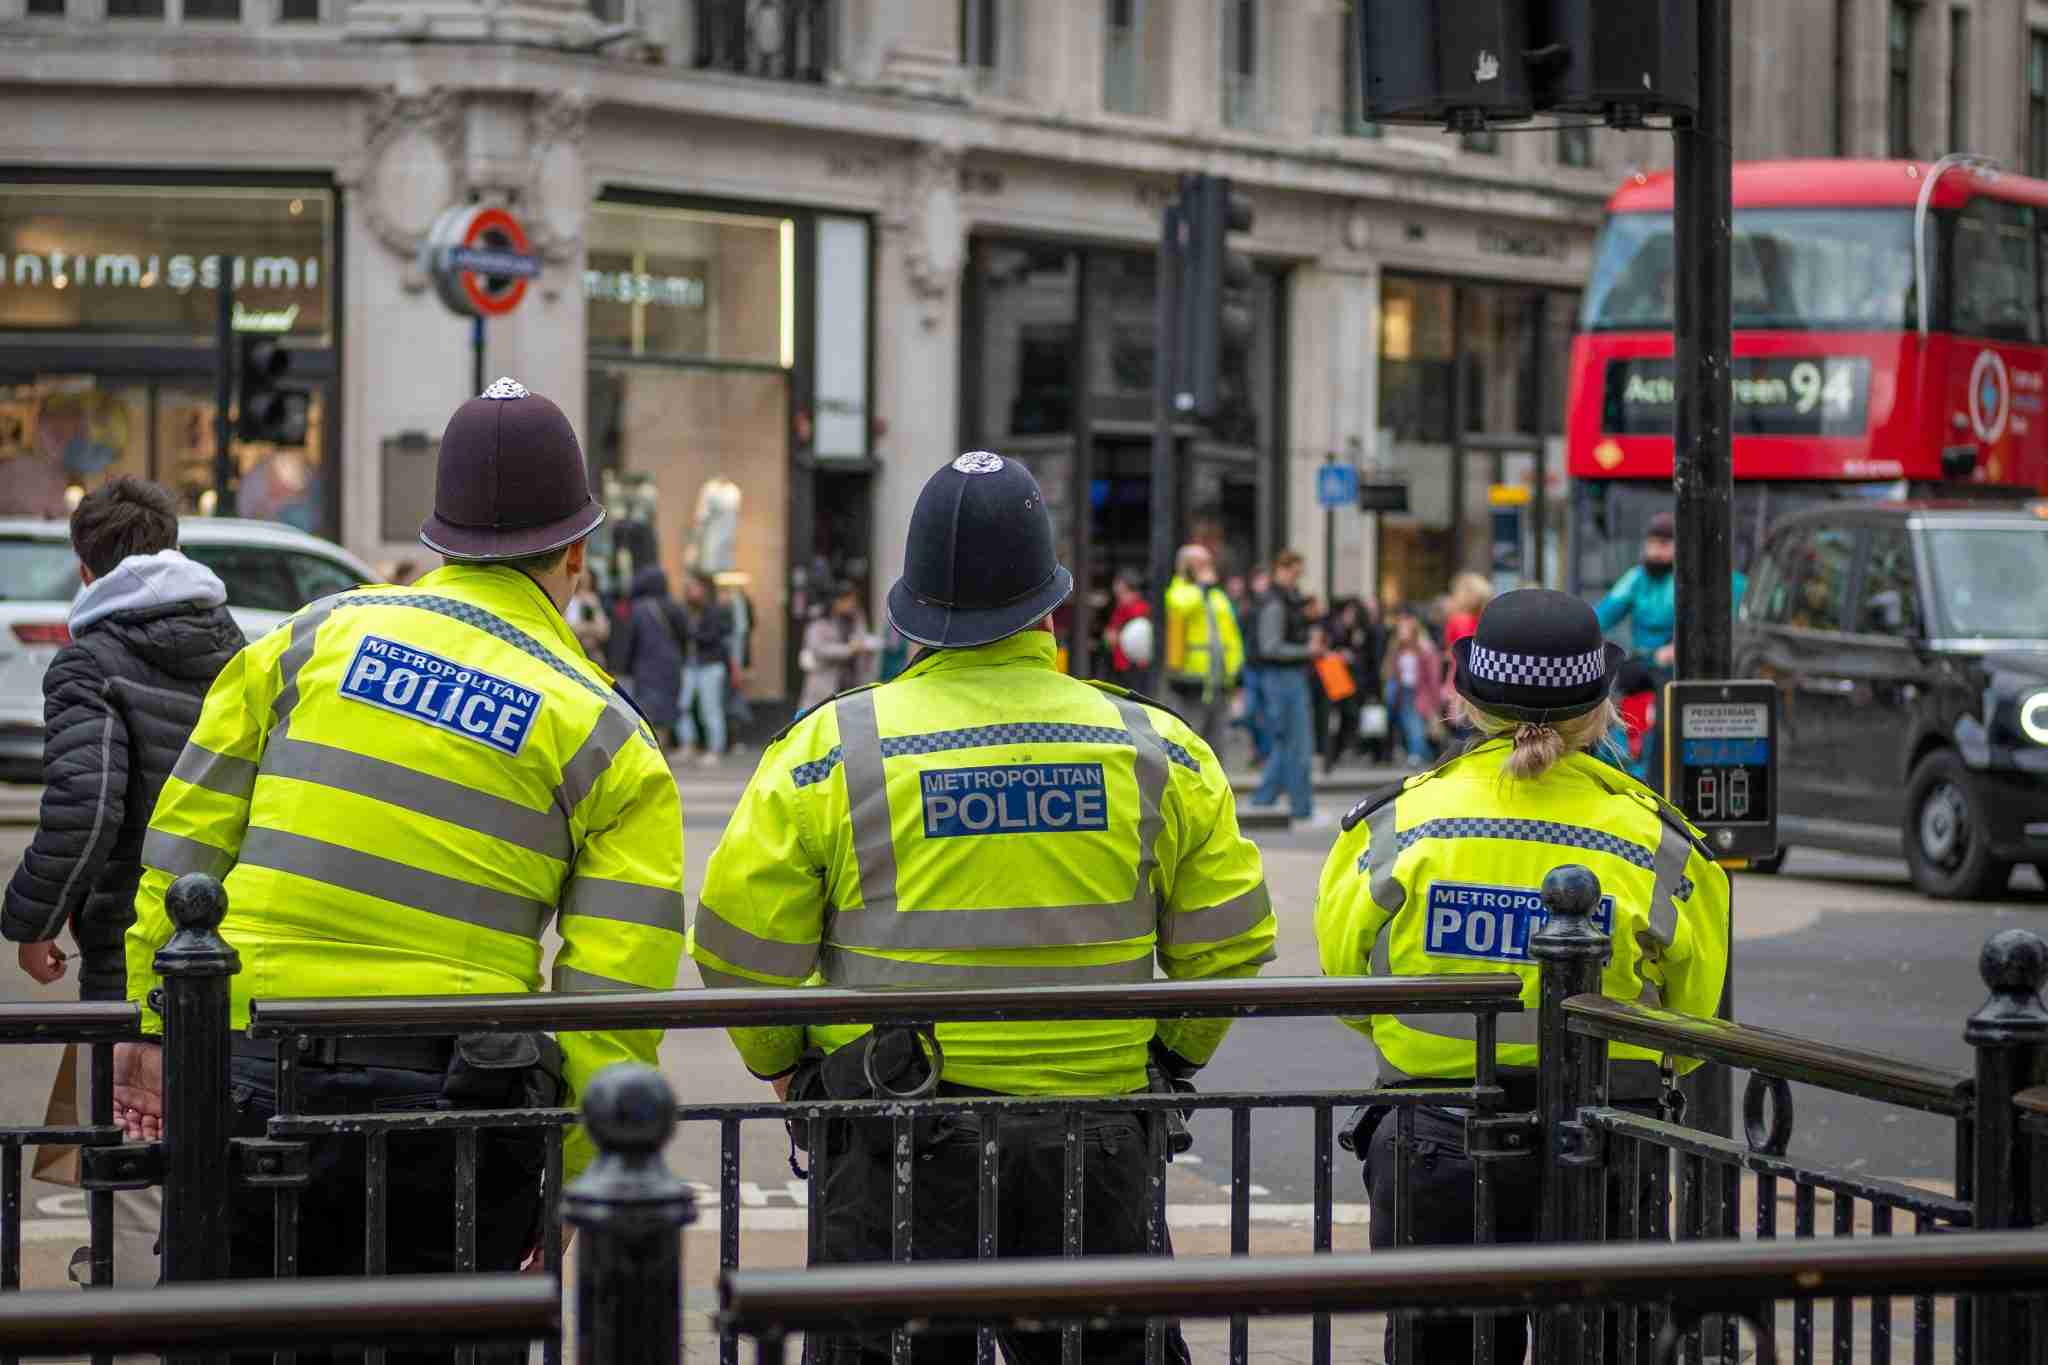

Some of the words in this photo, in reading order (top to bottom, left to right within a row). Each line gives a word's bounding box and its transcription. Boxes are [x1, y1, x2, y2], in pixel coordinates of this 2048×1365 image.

[1790, 362, 1854, 415] 94
[365, 640, 534, 708] METROPOLITAN
[349, 655, 526, 747] POLICE
[924, 768, 1100, 793] METROPOLITAN
[926, 788, 1105, 832] POLICE
